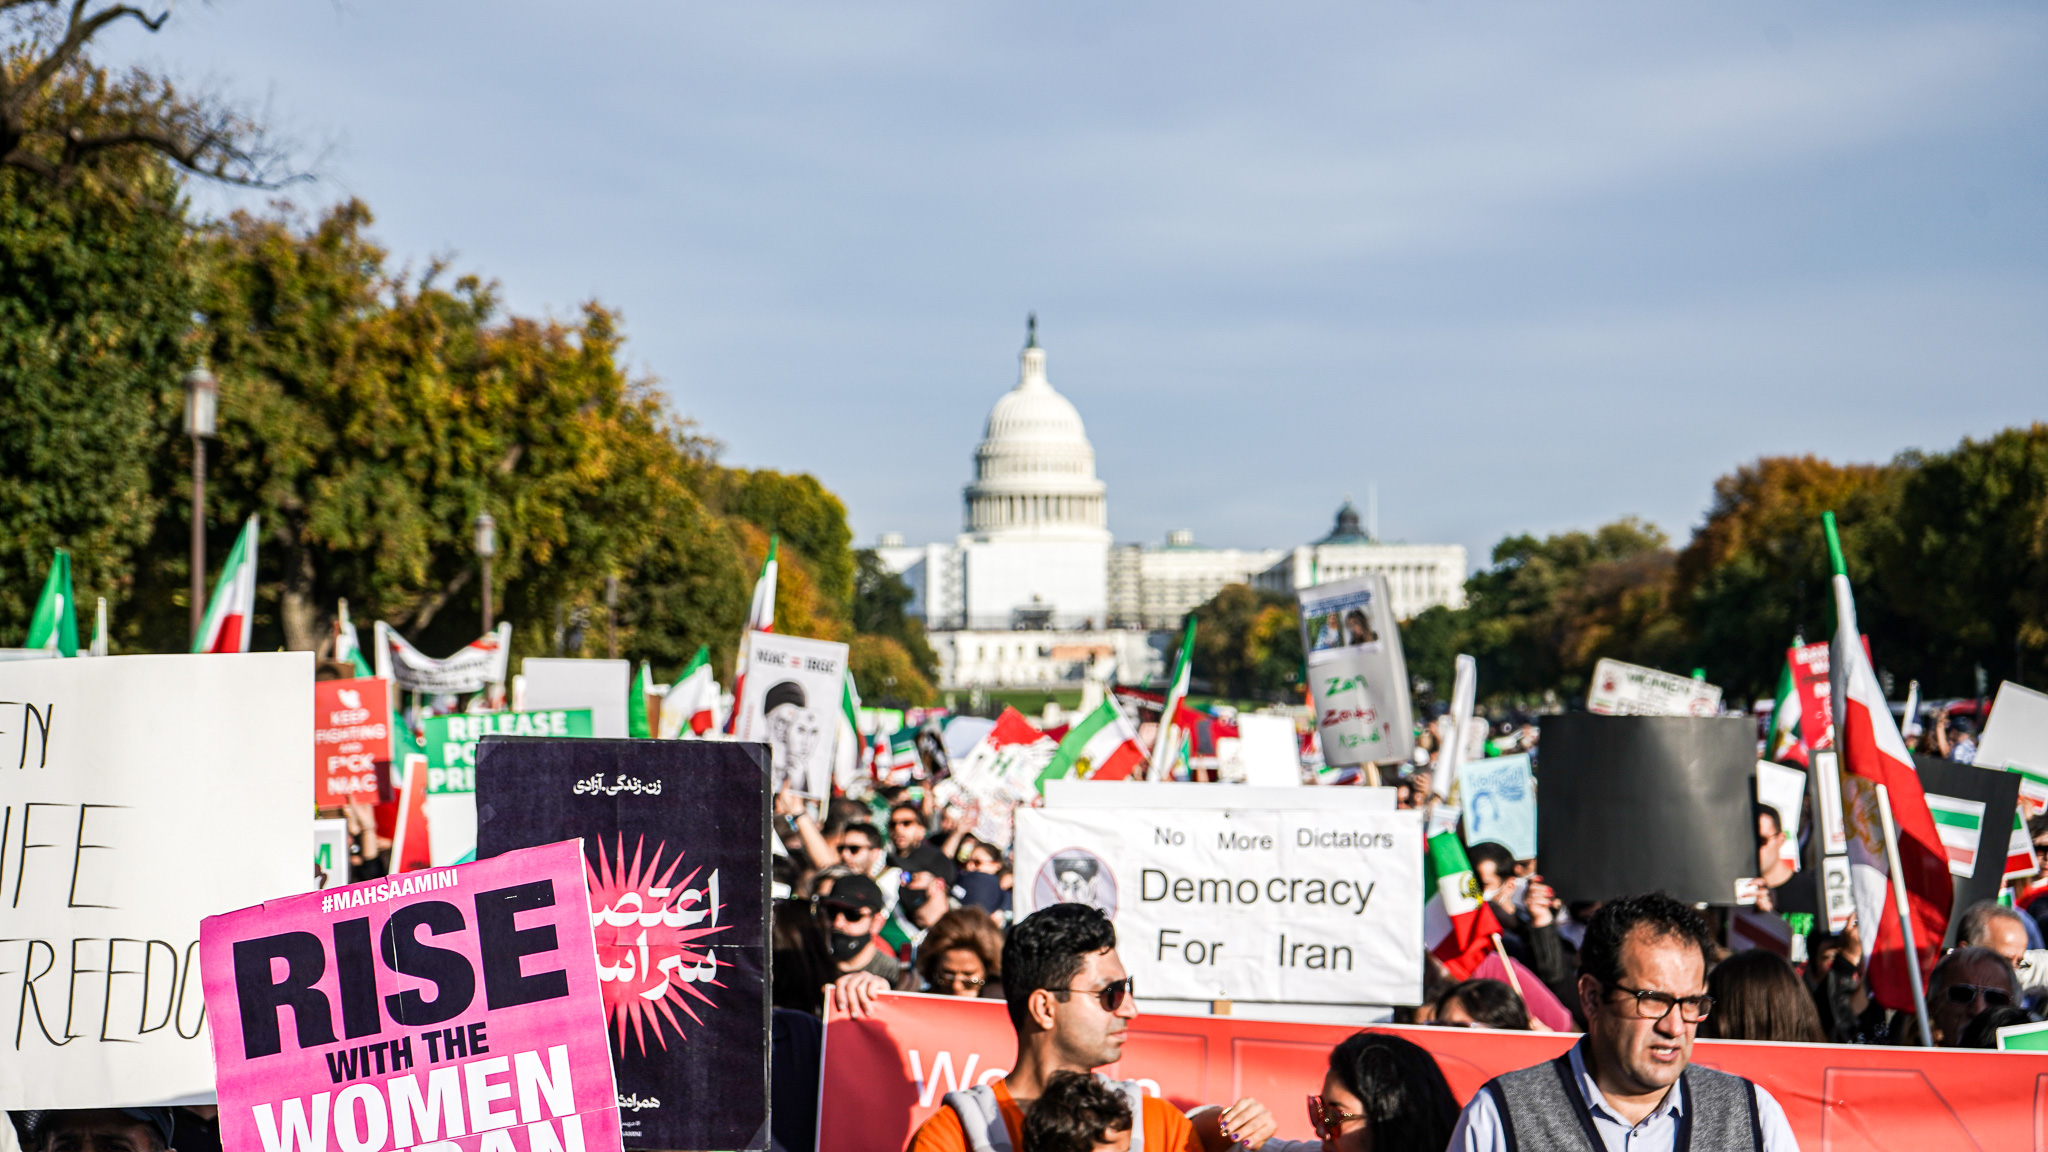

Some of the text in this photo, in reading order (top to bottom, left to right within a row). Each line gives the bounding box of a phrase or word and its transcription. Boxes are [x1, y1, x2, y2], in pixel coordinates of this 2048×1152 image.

[316, 723, 387, 745] FIGHTING
[330, 708, 370, 726] KEEP
[447, 711, 568, 741] RELEASE
[339, 742, 364, 754] AND
[327, 773, 378, 795] NIAC
[1154, 827, 1394, 851] No More Dictators
[321, 868, 458, 914] #MAHSAAMINI
[1140, 868, 1375, 916] Democracy
[1157, 928, 1353, 971] For Iran
[232, 878, 570, 1060] RISE
[325, 1021, 490, 1085] WITH THE
[252, 1044, 577, 1152] WOMEN
